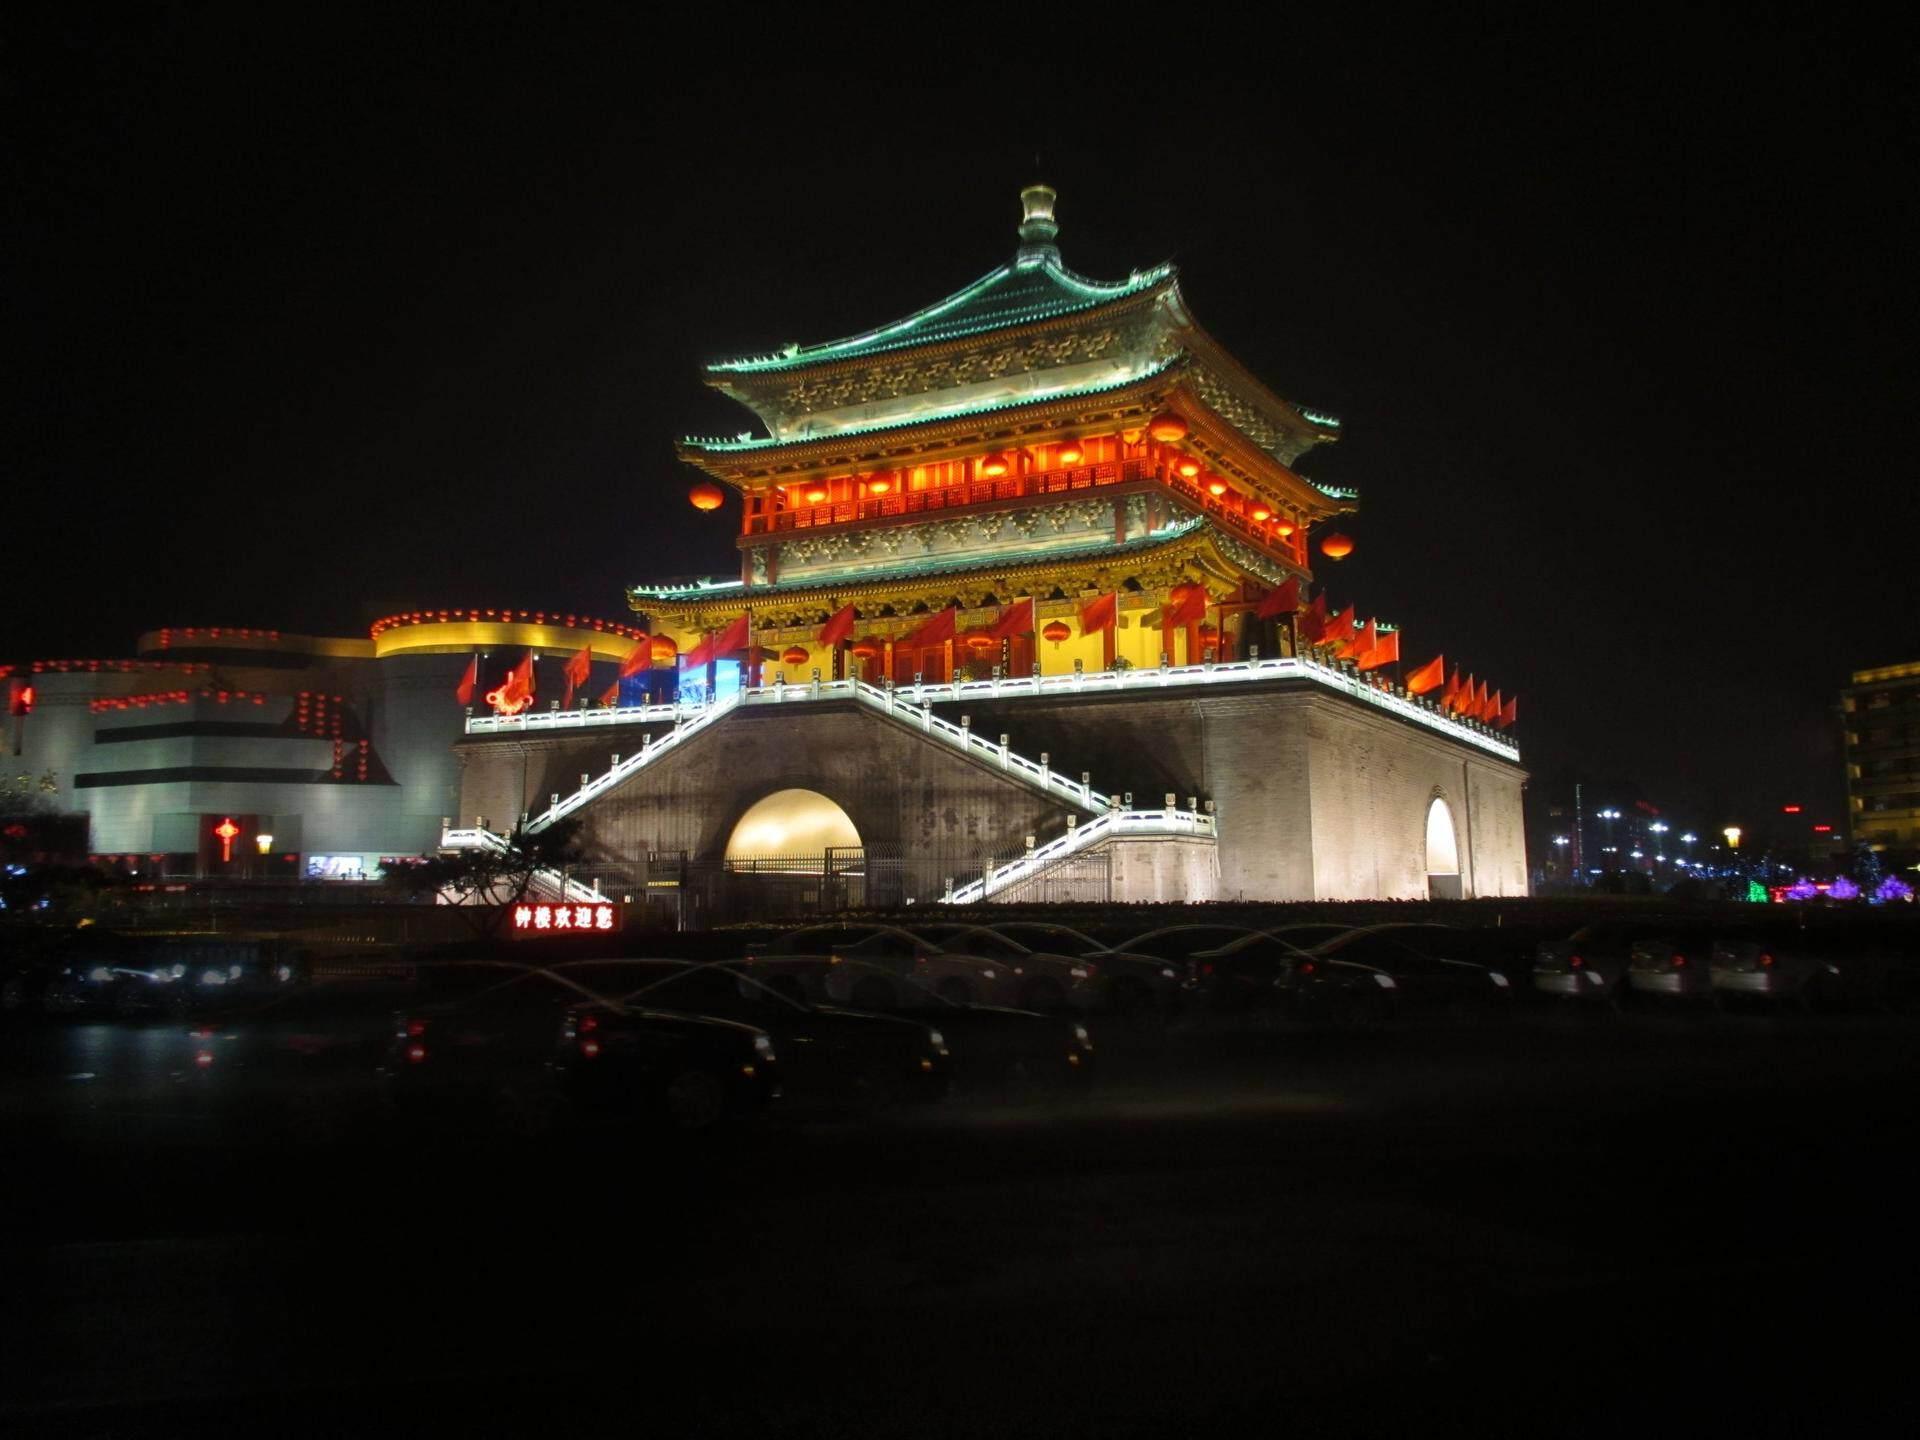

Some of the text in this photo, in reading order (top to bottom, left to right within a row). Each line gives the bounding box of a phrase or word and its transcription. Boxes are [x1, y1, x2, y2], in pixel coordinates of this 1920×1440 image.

[515, 906, 613, 929] 钟楼欢迎您
